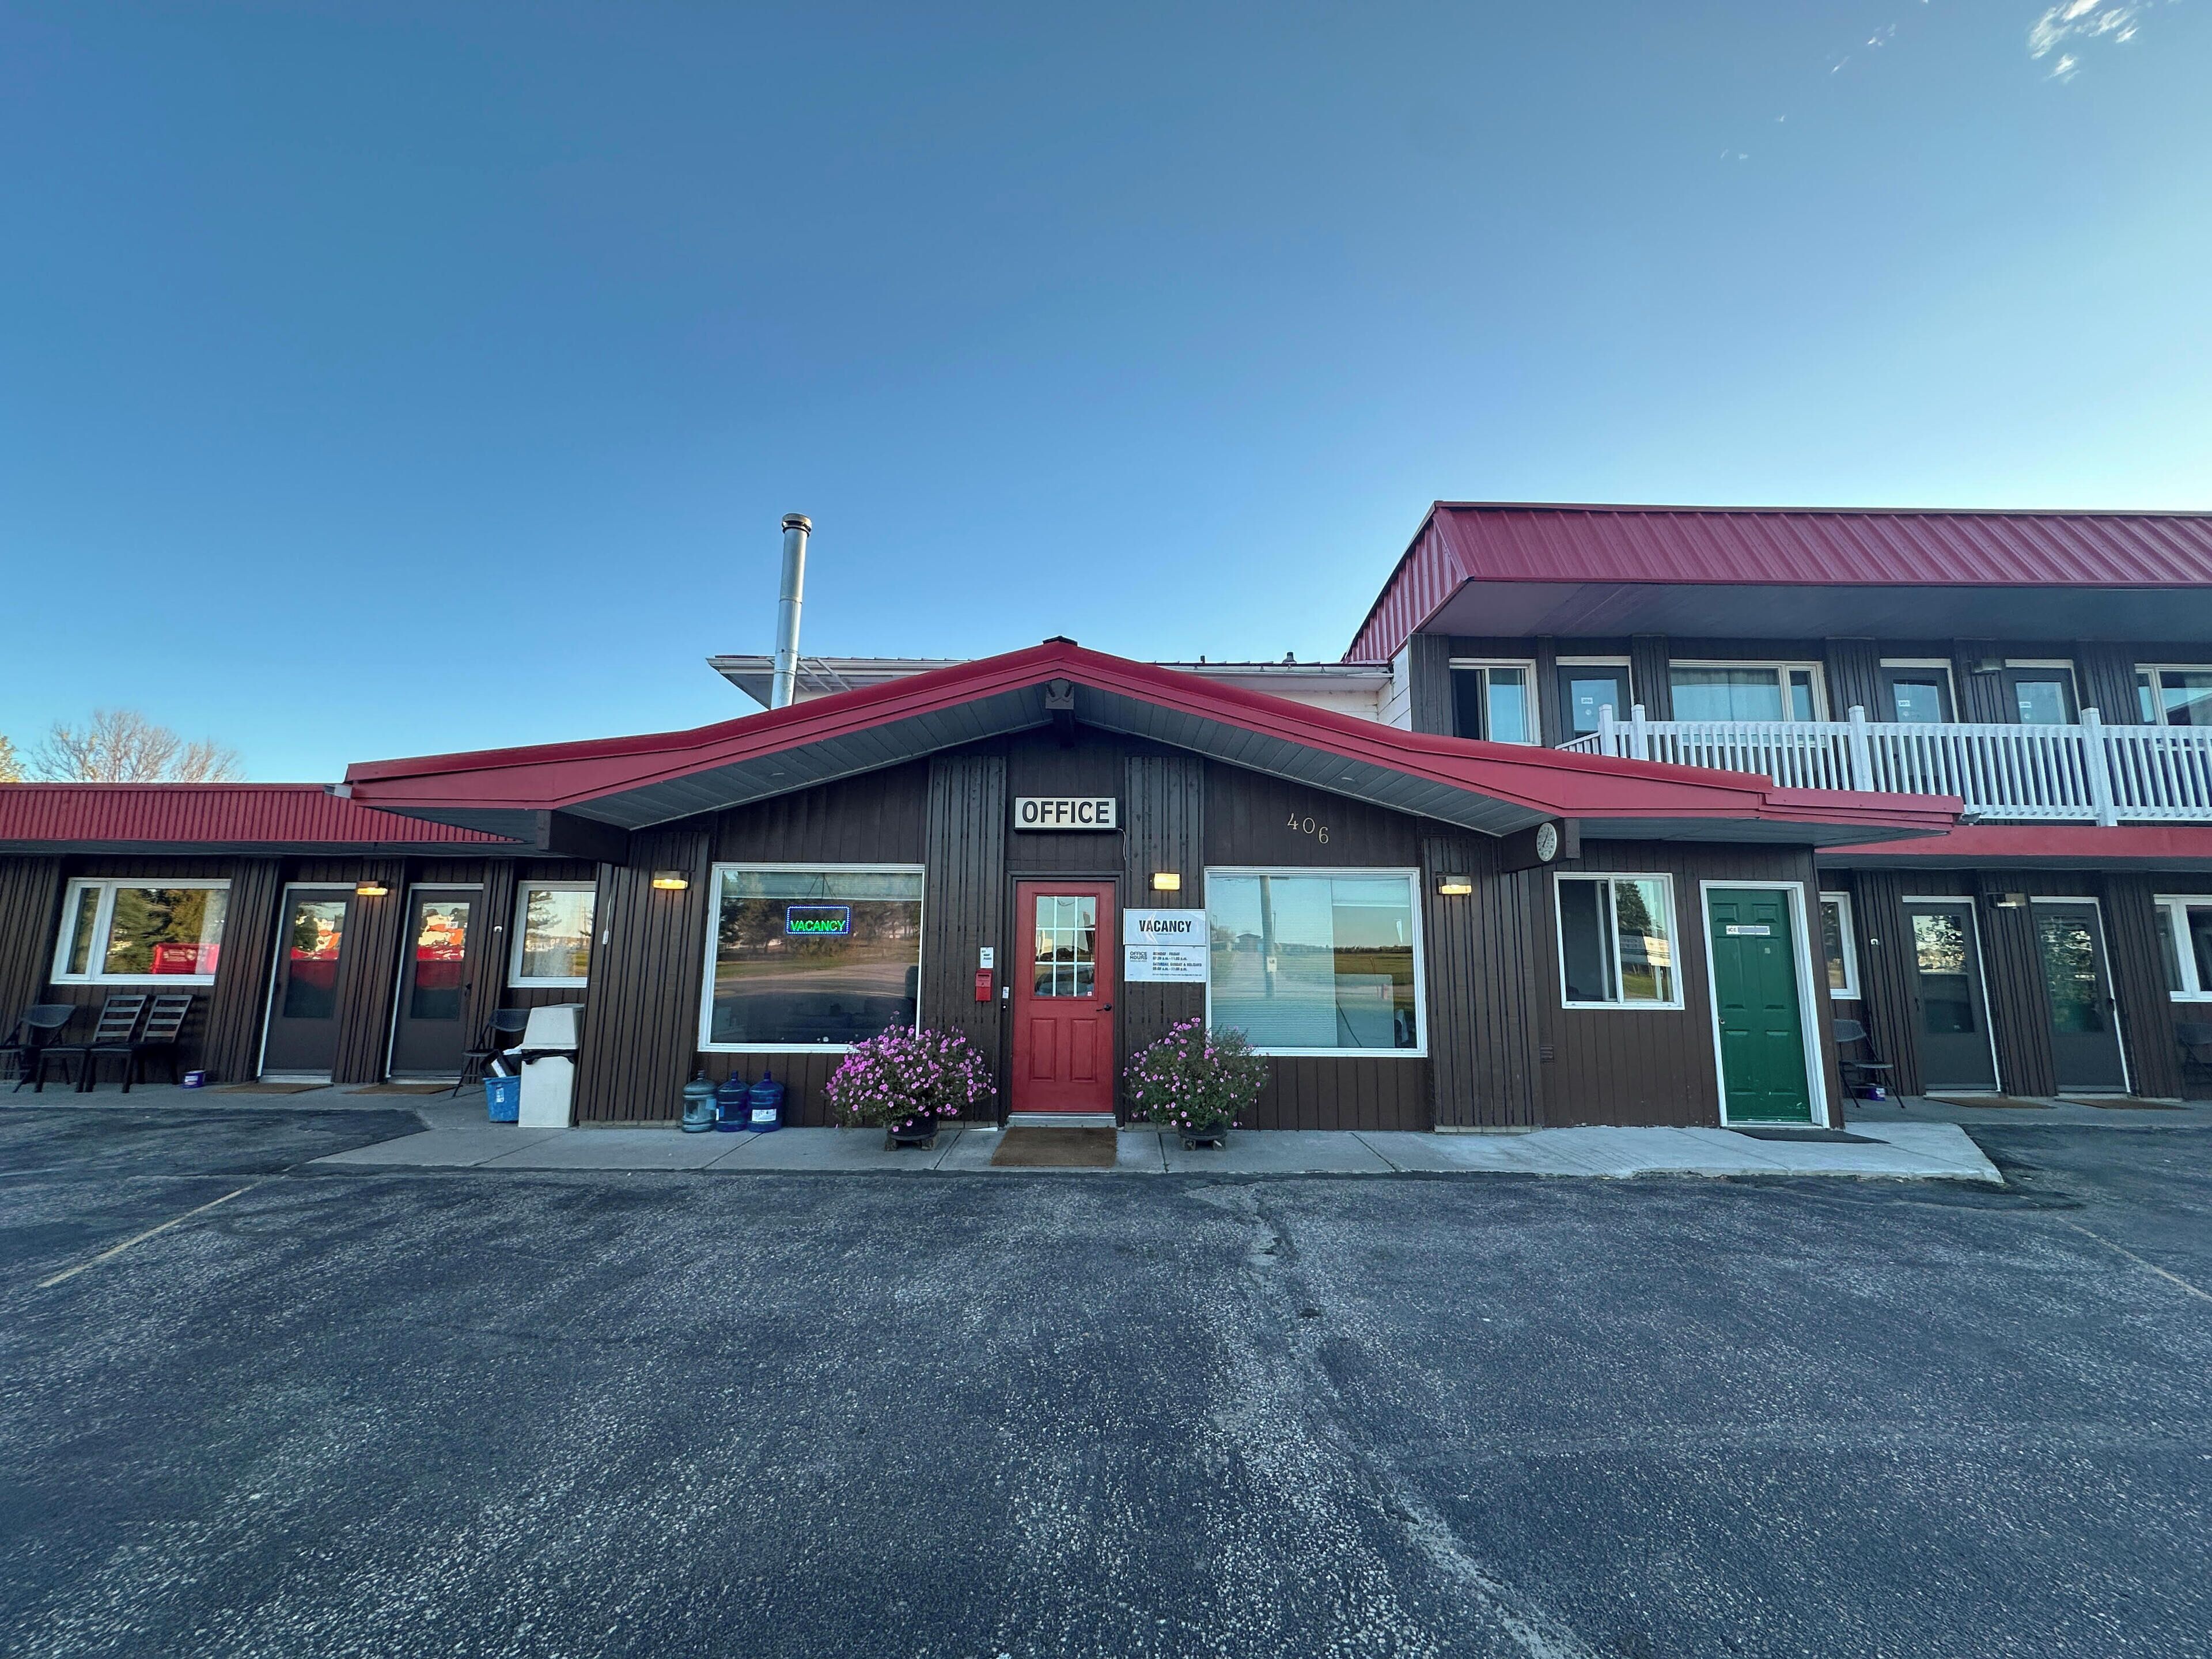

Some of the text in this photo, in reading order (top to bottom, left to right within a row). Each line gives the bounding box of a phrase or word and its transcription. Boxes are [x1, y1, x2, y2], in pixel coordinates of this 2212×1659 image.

[1022, 801, 1109, 823] OFFICE
[1287, 813, 1329, 844] 406
[790, 920, 846, 931] VACANCY
[1139, 920, 1192, 933] VACANCY
